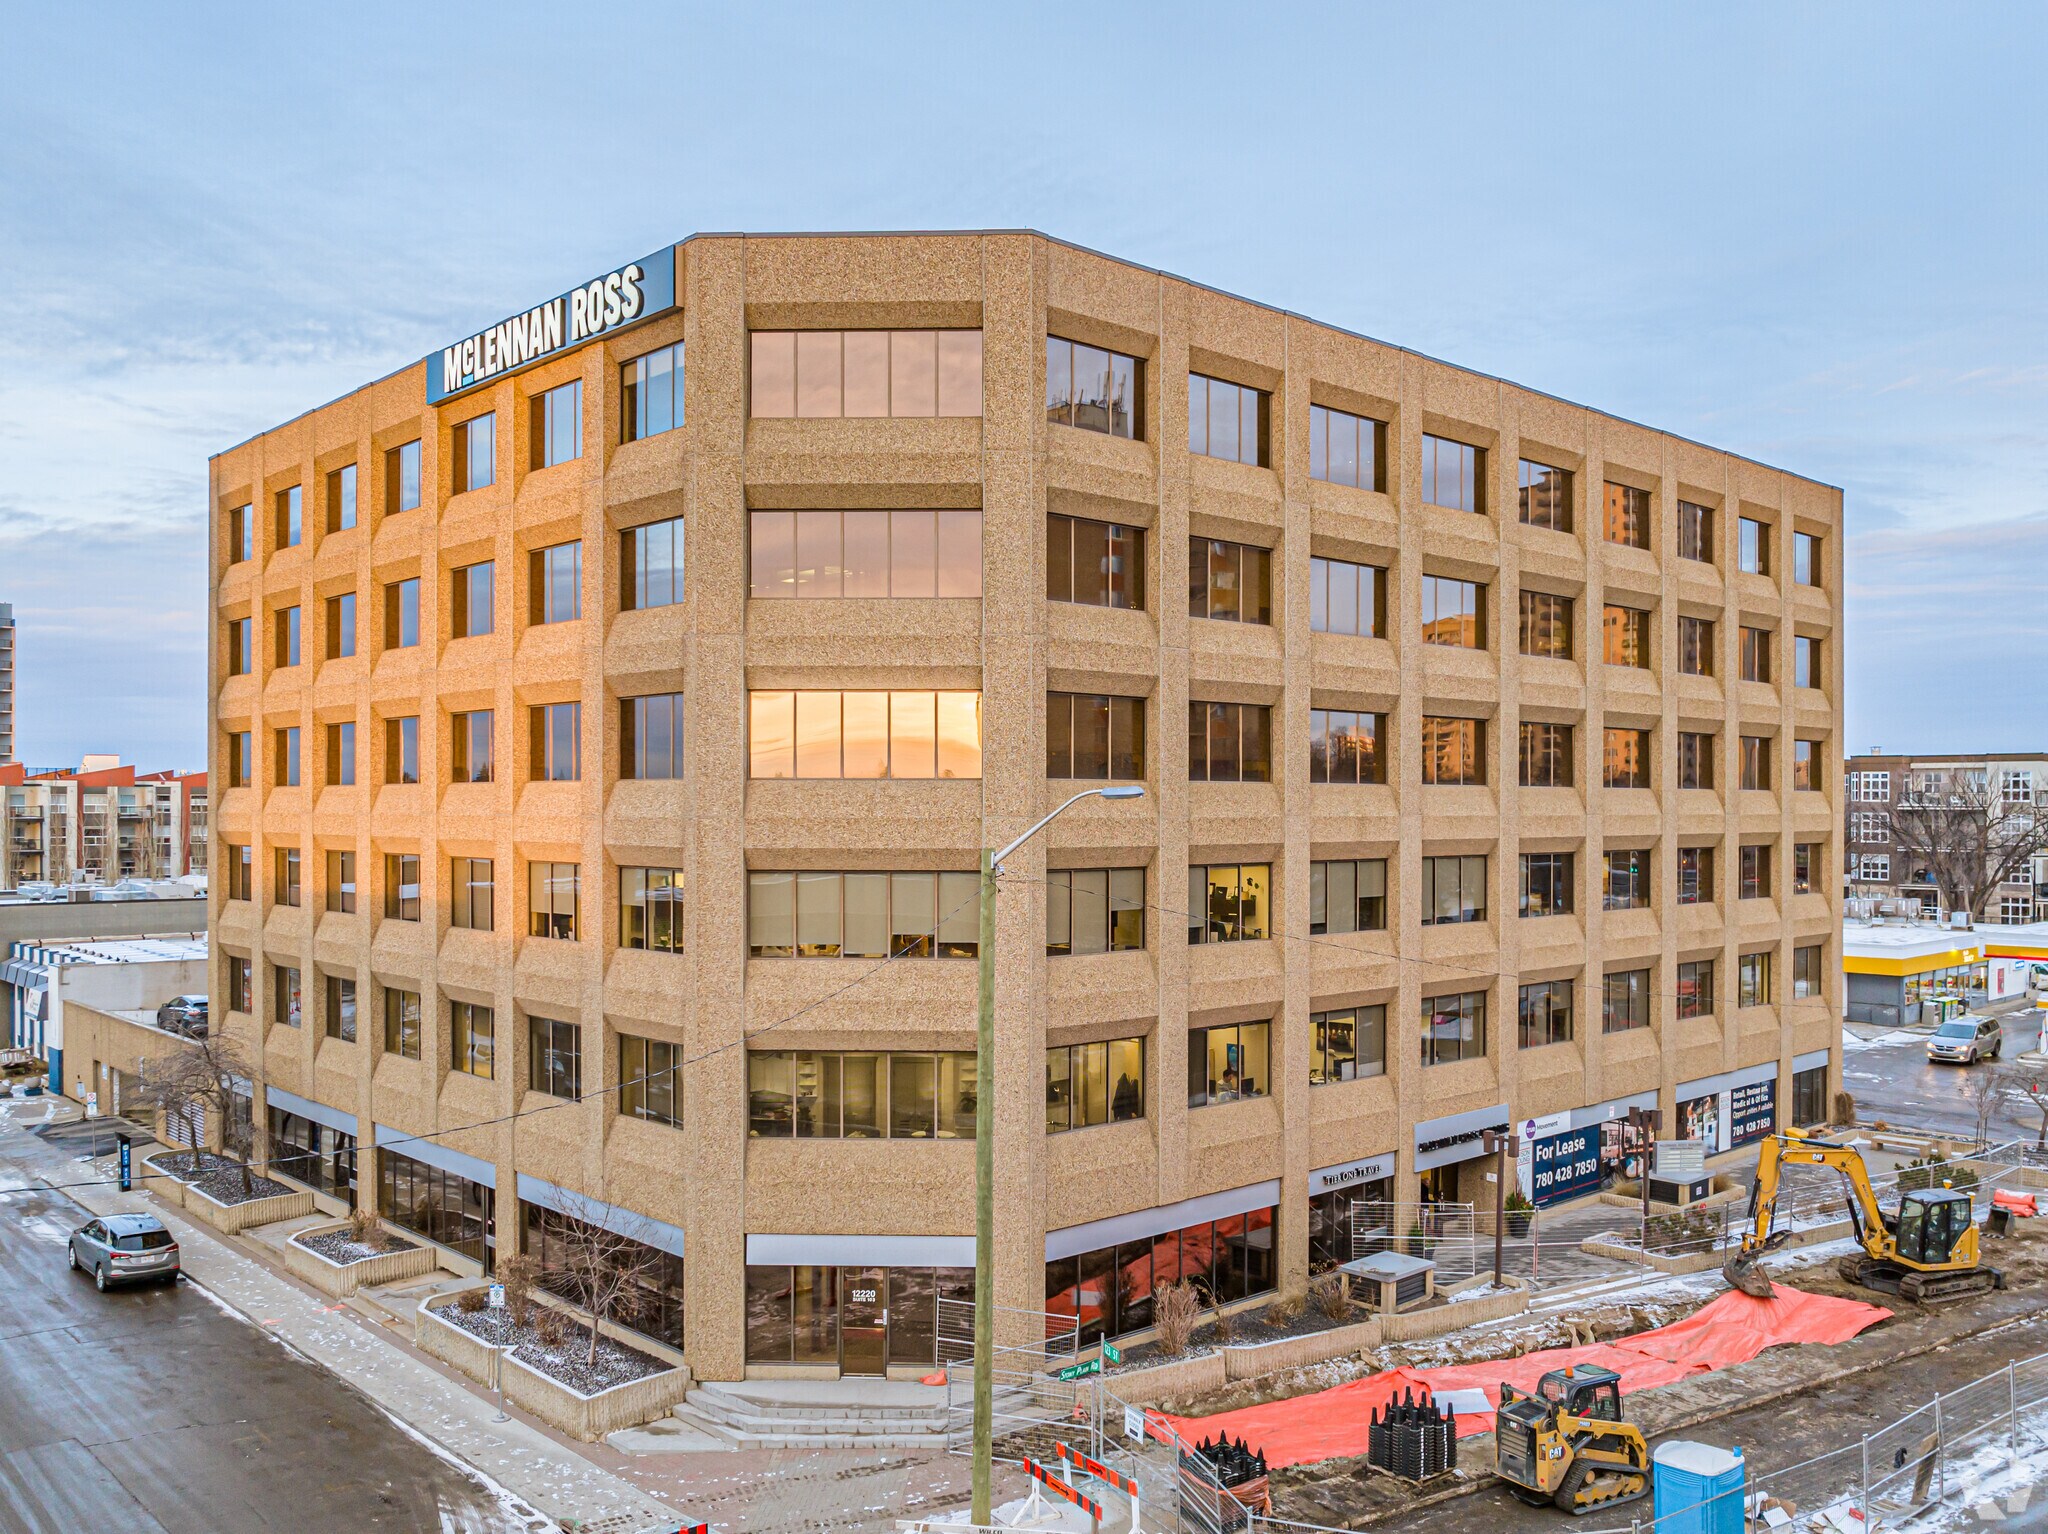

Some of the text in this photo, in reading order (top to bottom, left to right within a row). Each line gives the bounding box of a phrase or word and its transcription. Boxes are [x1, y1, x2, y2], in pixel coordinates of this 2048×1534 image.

[571, 264, 643, 341] ROSS
[1537, 1120, 1558, 1130] Movement
[1732, 1117, 1770, 1137] 780 428 7850
[1536, 1137, 1586, 1162] For Lease
[1326, 1174, 1342, 1185] TIER
[1342, 1170, 1358, 1181] ONE
[1536, 1158, 1596, 1189] 780 428 7850
[1113, 1350, 1118, 1361] ST
[1549, 1446, 1563, 1459] CAT
